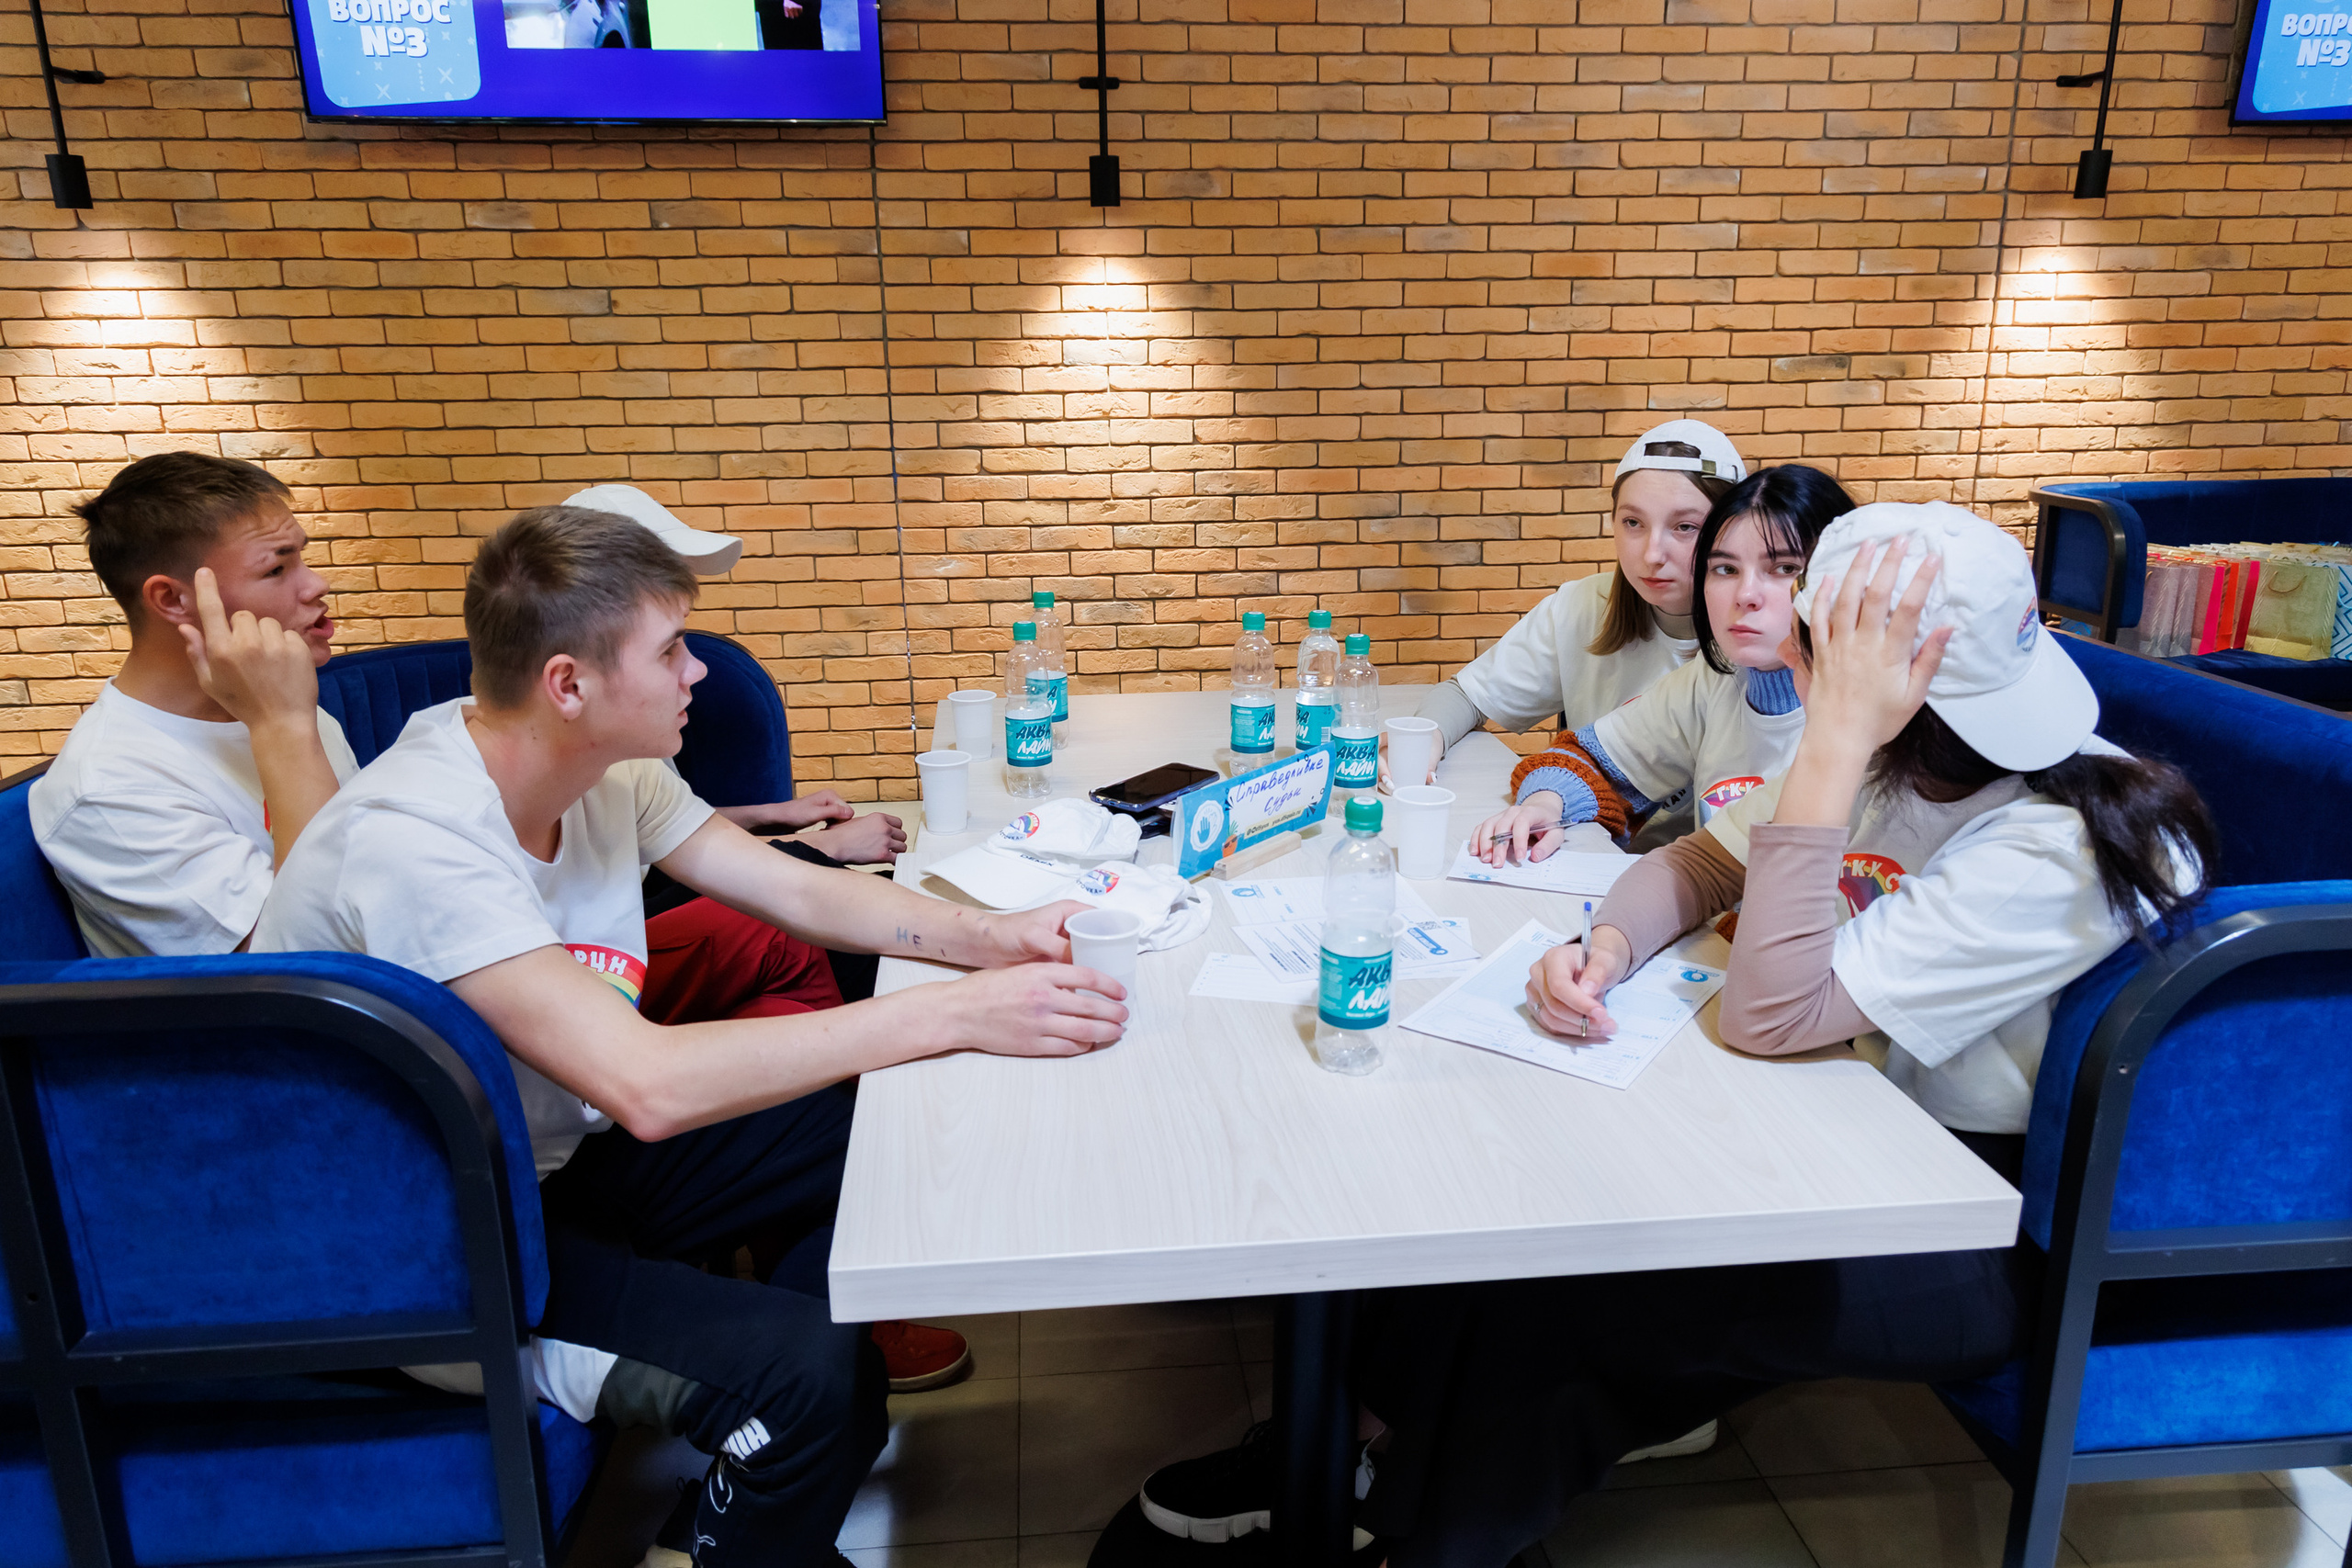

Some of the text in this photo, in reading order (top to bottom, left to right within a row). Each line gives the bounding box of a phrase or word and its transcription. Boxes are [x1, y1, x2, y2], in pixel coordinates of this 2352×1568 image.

[328, 0, 452, 24] ВОПРОС
[359, 25, 428, 58] №3
[2296, 39, 2352, 67] №3
[1336, 743, 1376, 761] АКВА
[1336, 759, 1376, 777] ЛАЙН
[569, 949, 628, 976] РЦН
